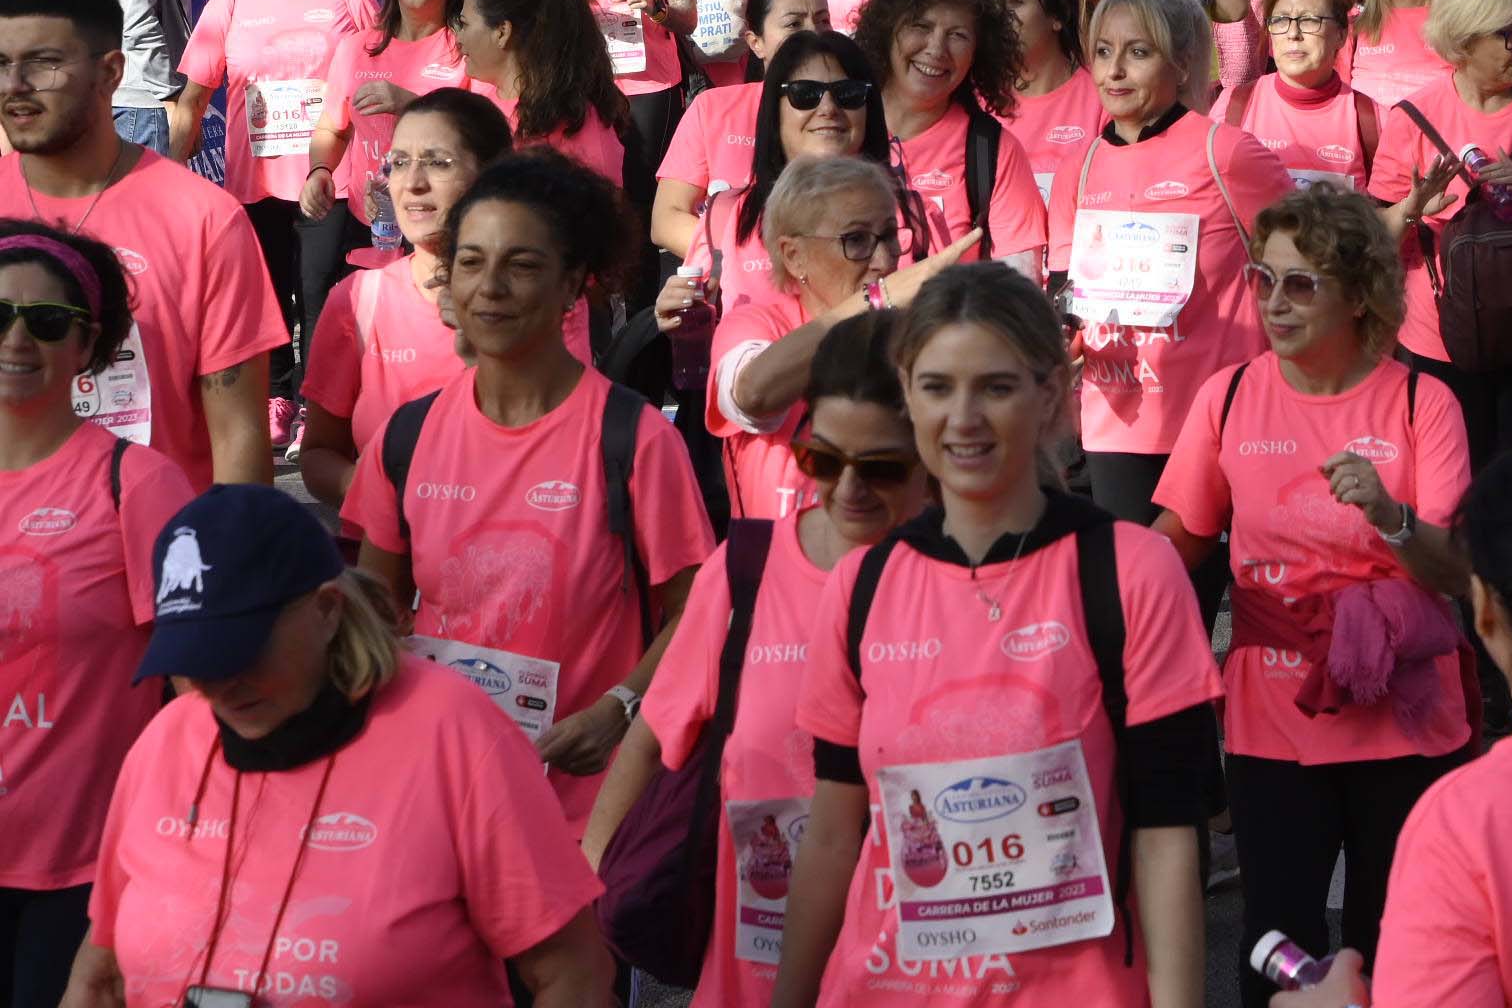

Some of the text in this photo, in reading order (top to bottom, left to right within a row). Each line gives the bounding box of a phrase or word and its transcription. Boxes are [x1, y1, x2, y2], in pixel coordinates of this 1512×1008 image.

[727, 134, 756, 147] OYS
[116, 412, 139, 423] 2023
[1239, 439, 1297, 458] OYSHO
[416, 482, 477, 502] OYSHO
[867, 638, 942, 663] OYSHO
[938, 793, 1024, 817] ASTURIANA
[951, 833, 1026, 869] 016
[968, 871, 1016, 893] 7552
[916, 882, 1087, 918] CARRERA DE LA MUJER 2023
[1029, 910, 1097, 933] Santander
[916, 927, 978, 948] OYSHO
[274, 938, 340, 965] POR
[233, 969, 338, 998] TODAS
